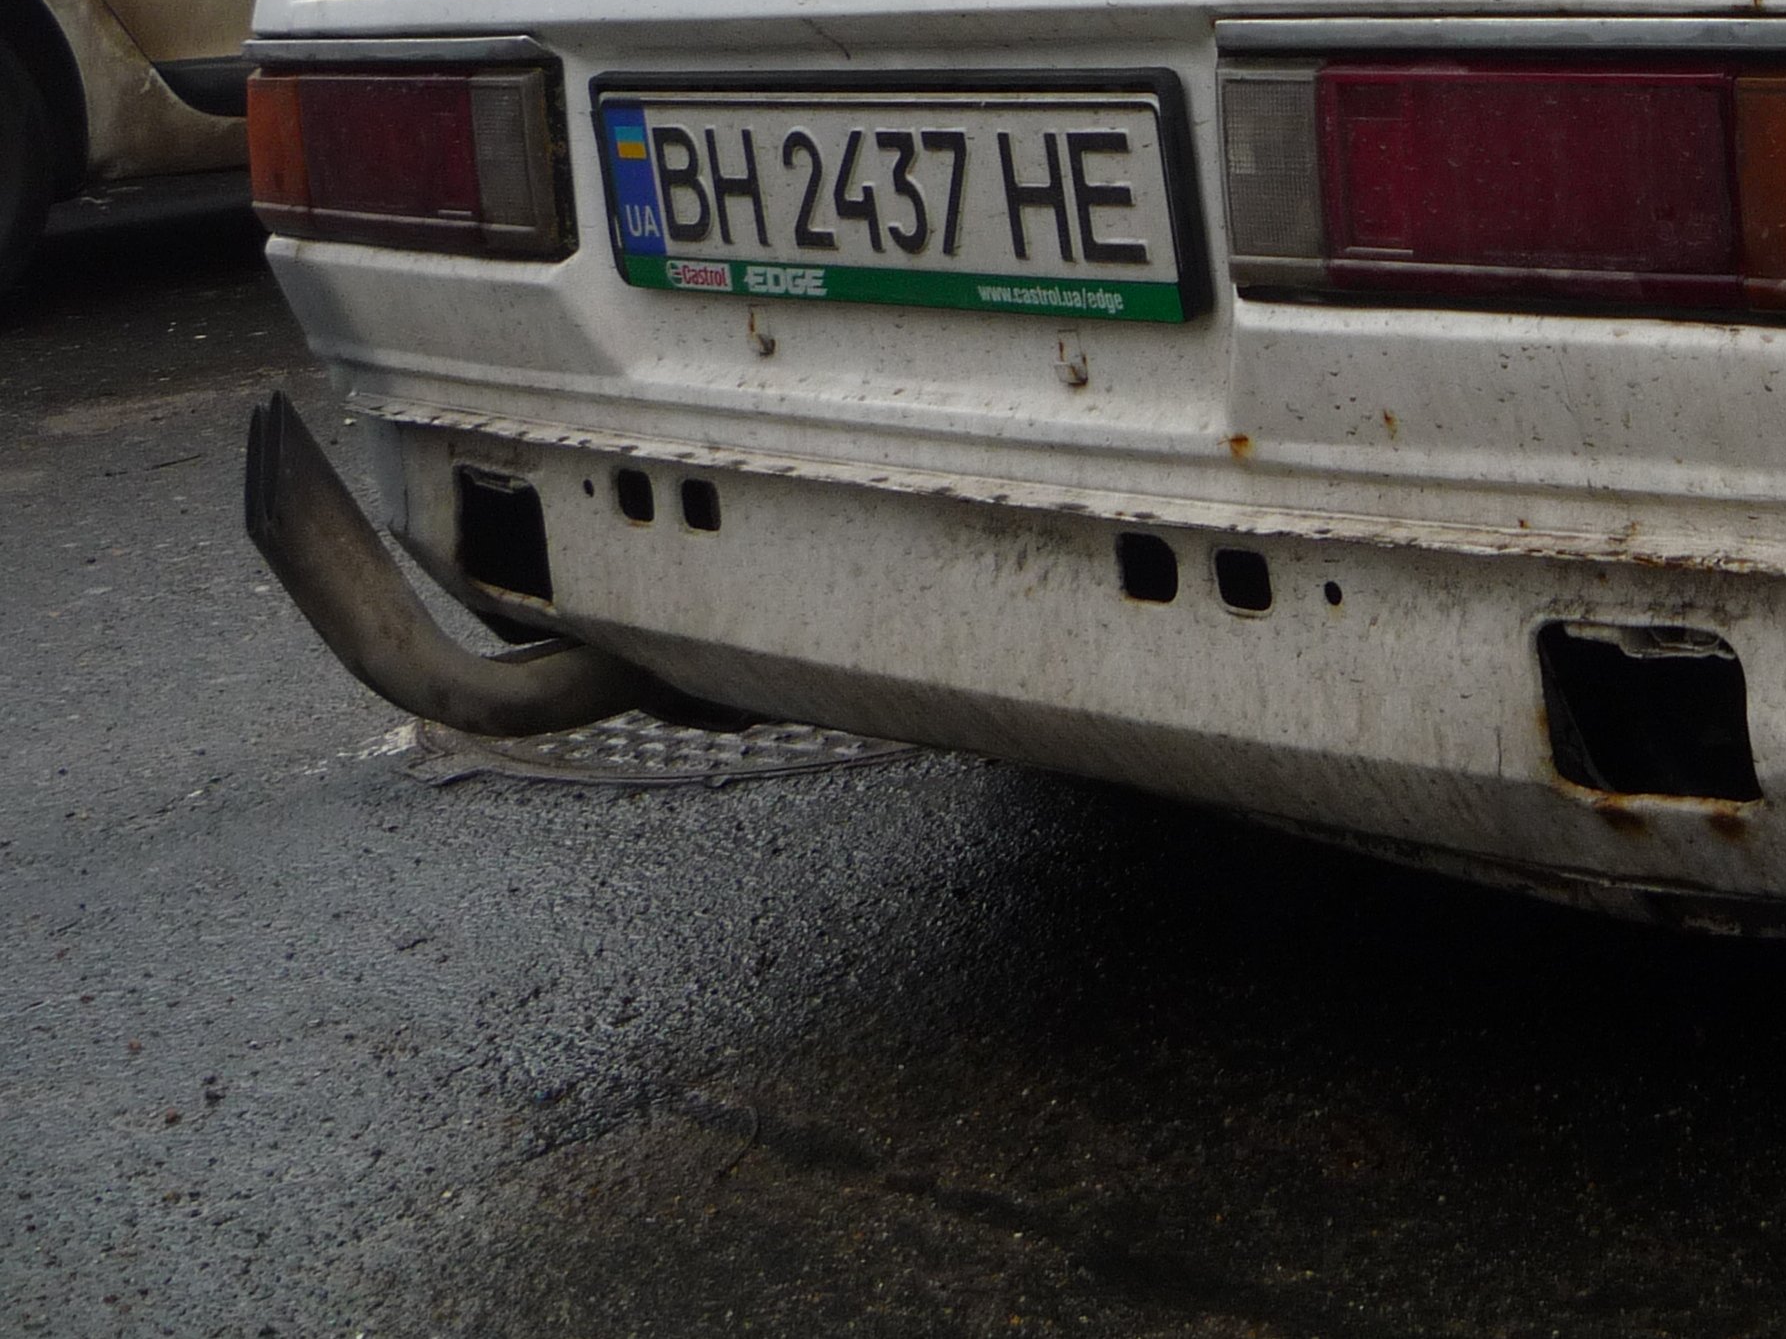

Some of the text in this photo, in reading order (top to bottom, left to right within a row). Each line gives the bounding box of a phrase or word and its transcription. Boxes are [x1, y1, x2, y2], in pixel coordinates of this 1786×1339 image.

[652, 126, 1148, 264] BH 2437 HE
[627, 204, 660, 239] UA
[682, 264, 828, 297] Castrol EDGE
[977, 284, 1124, 314] www.castrol.ua/edge
